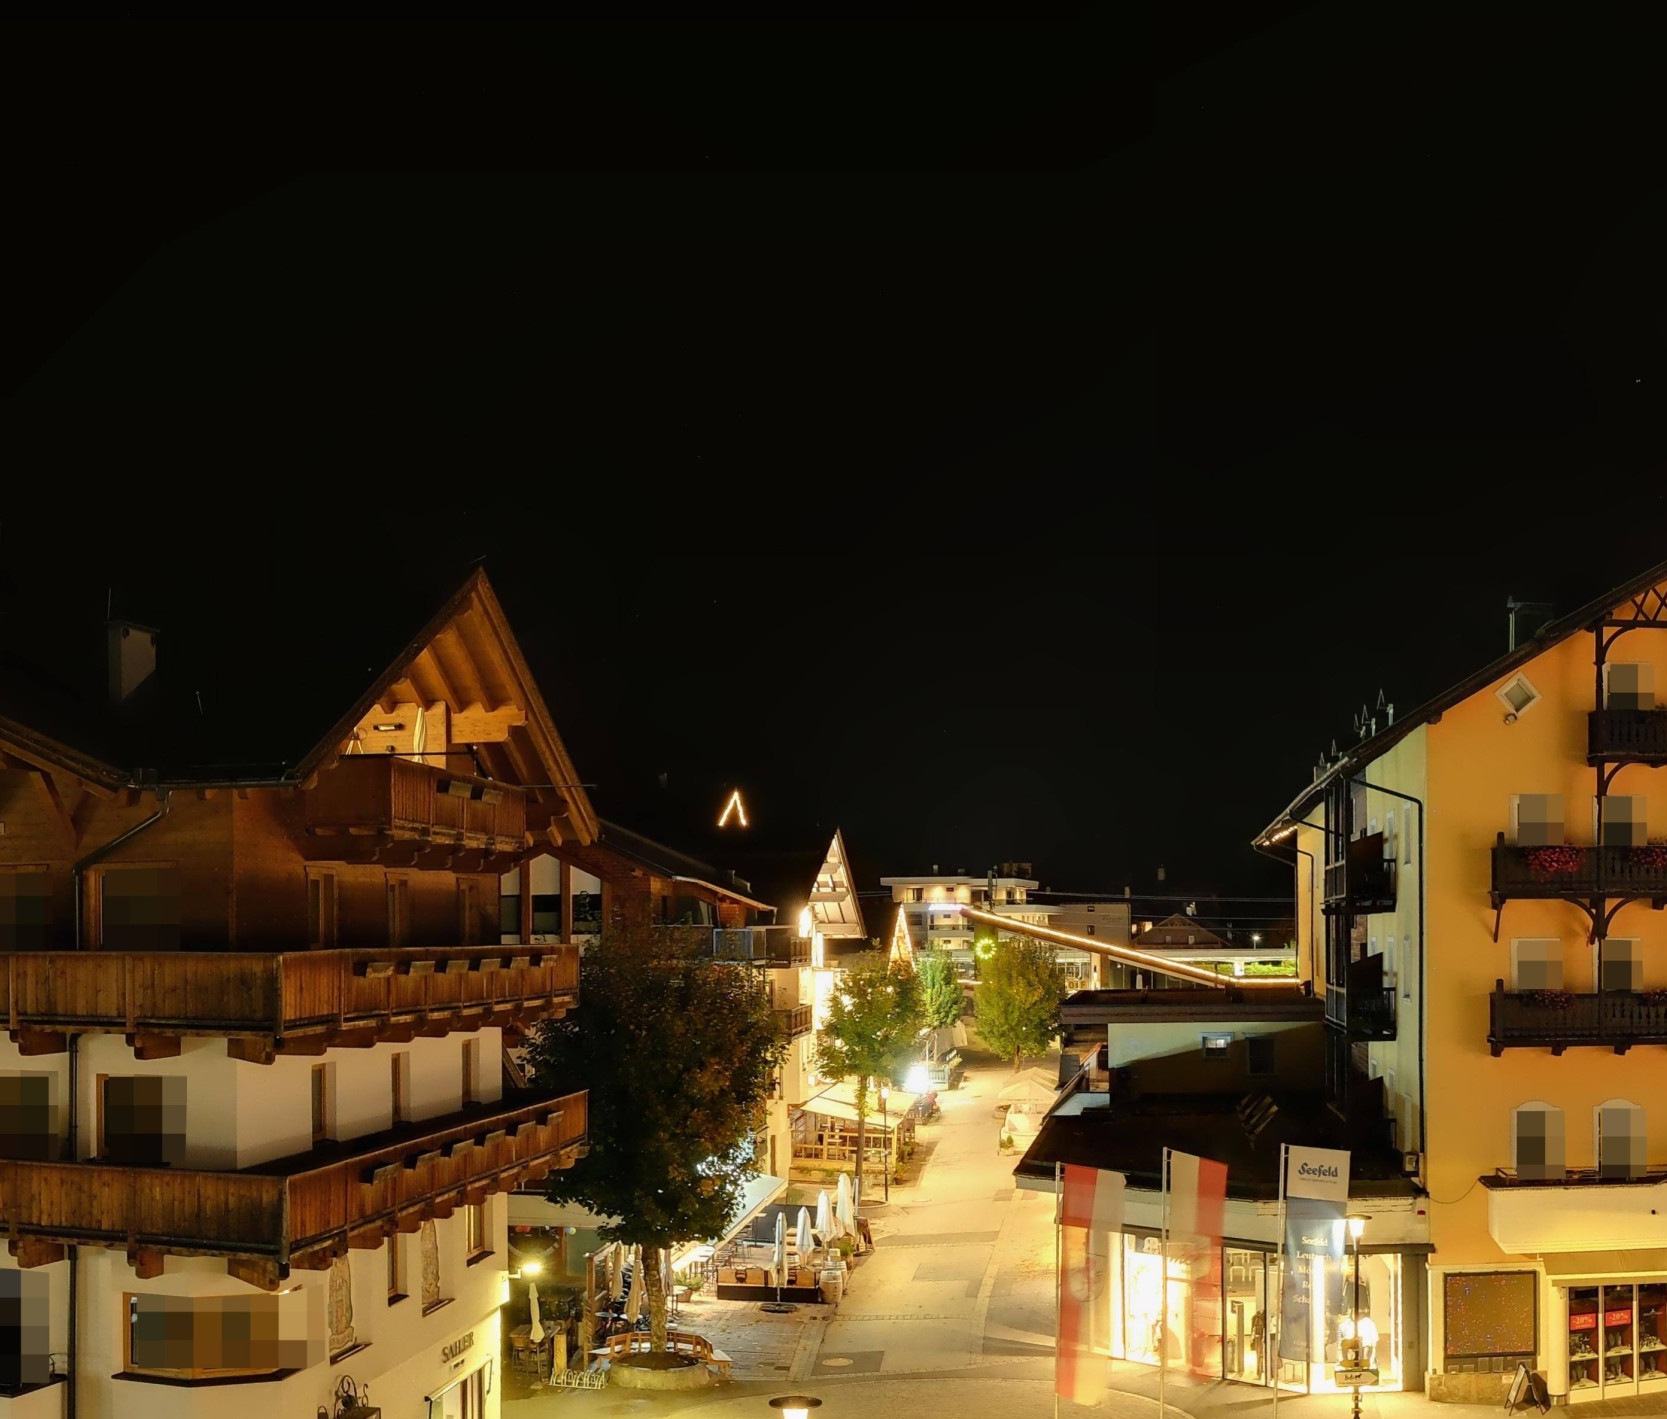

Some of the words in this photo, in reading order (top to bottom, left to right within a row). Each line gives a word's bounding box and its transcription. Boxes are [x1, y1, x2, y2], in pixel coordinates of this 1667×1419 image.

[1298, 1162, 1338, 1178] Seefeld
[1302, 1236, 1328, 1247] Seefeld
[441, 1331, 474, 1364] SAILER
